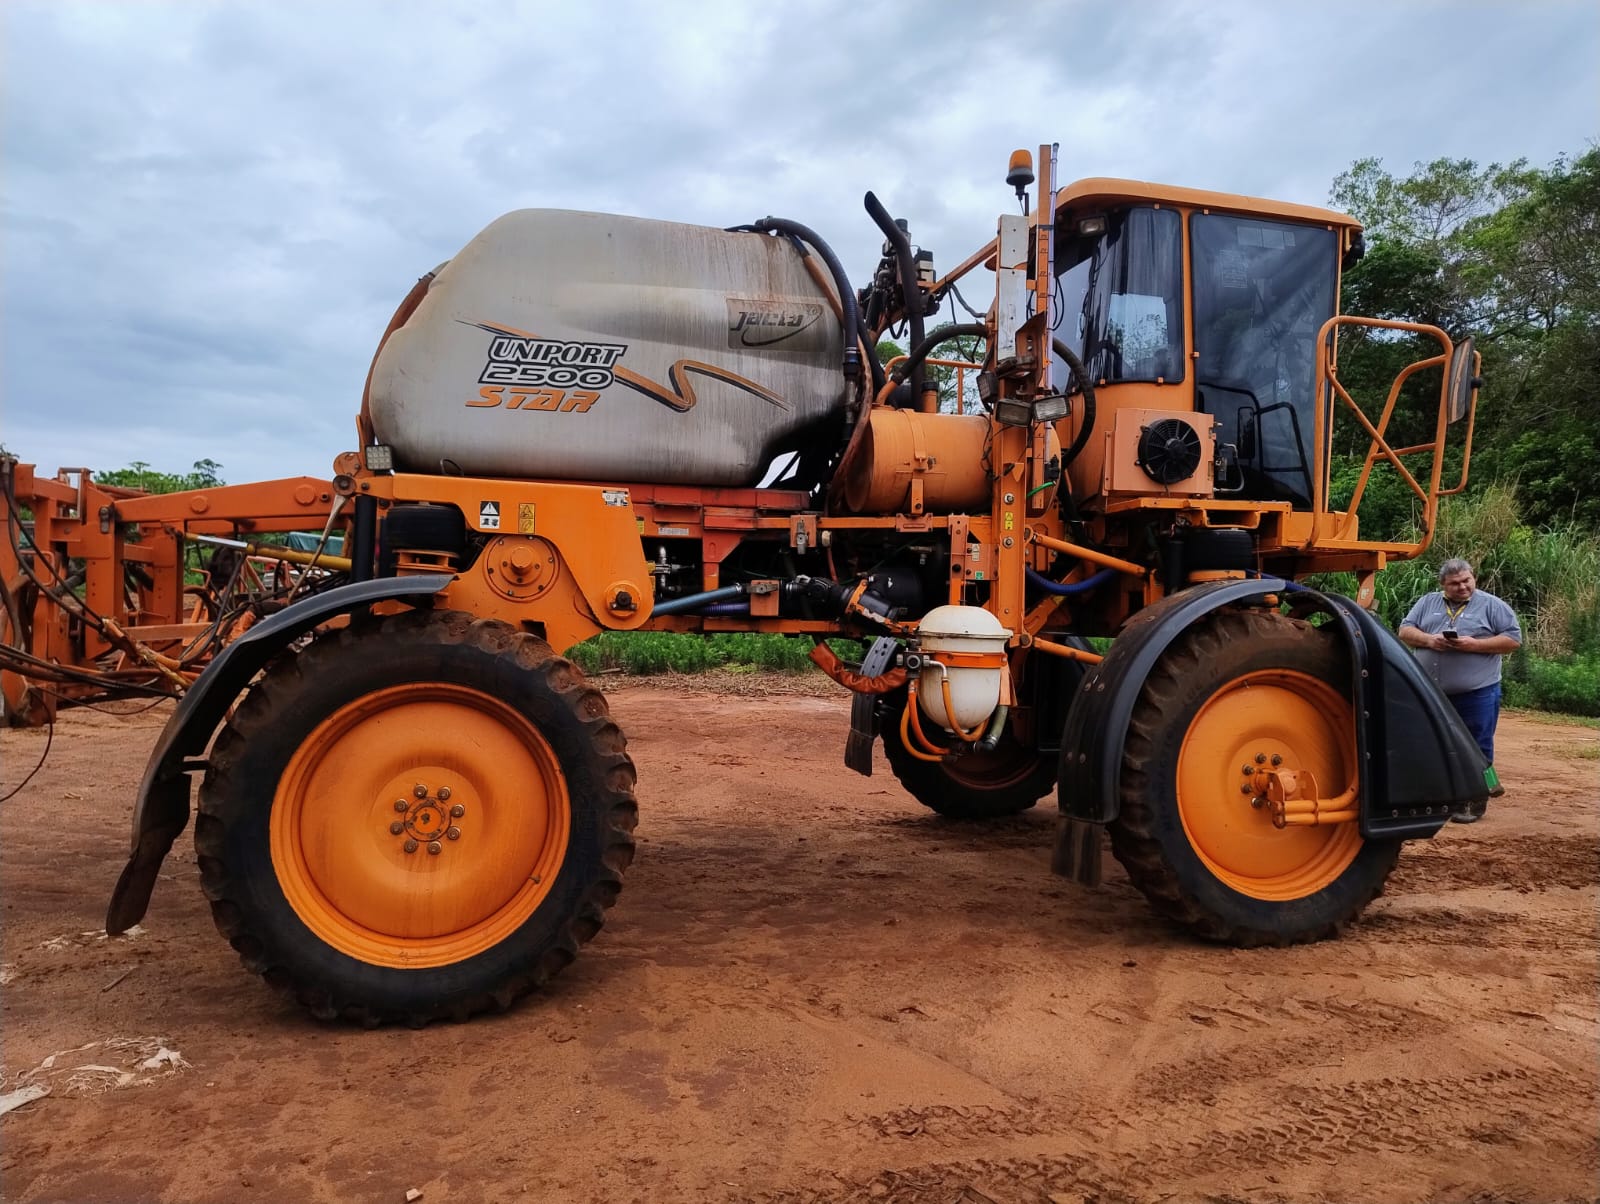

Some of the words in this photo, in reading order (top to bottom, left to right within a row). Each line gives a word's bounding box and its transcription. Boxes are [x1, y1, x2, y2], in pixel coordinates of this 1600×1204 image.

[490, 337, 627, 368] UNIPORT
[479, 361, 613, 389] 2500
[465, 386, 600, 412] STAR
